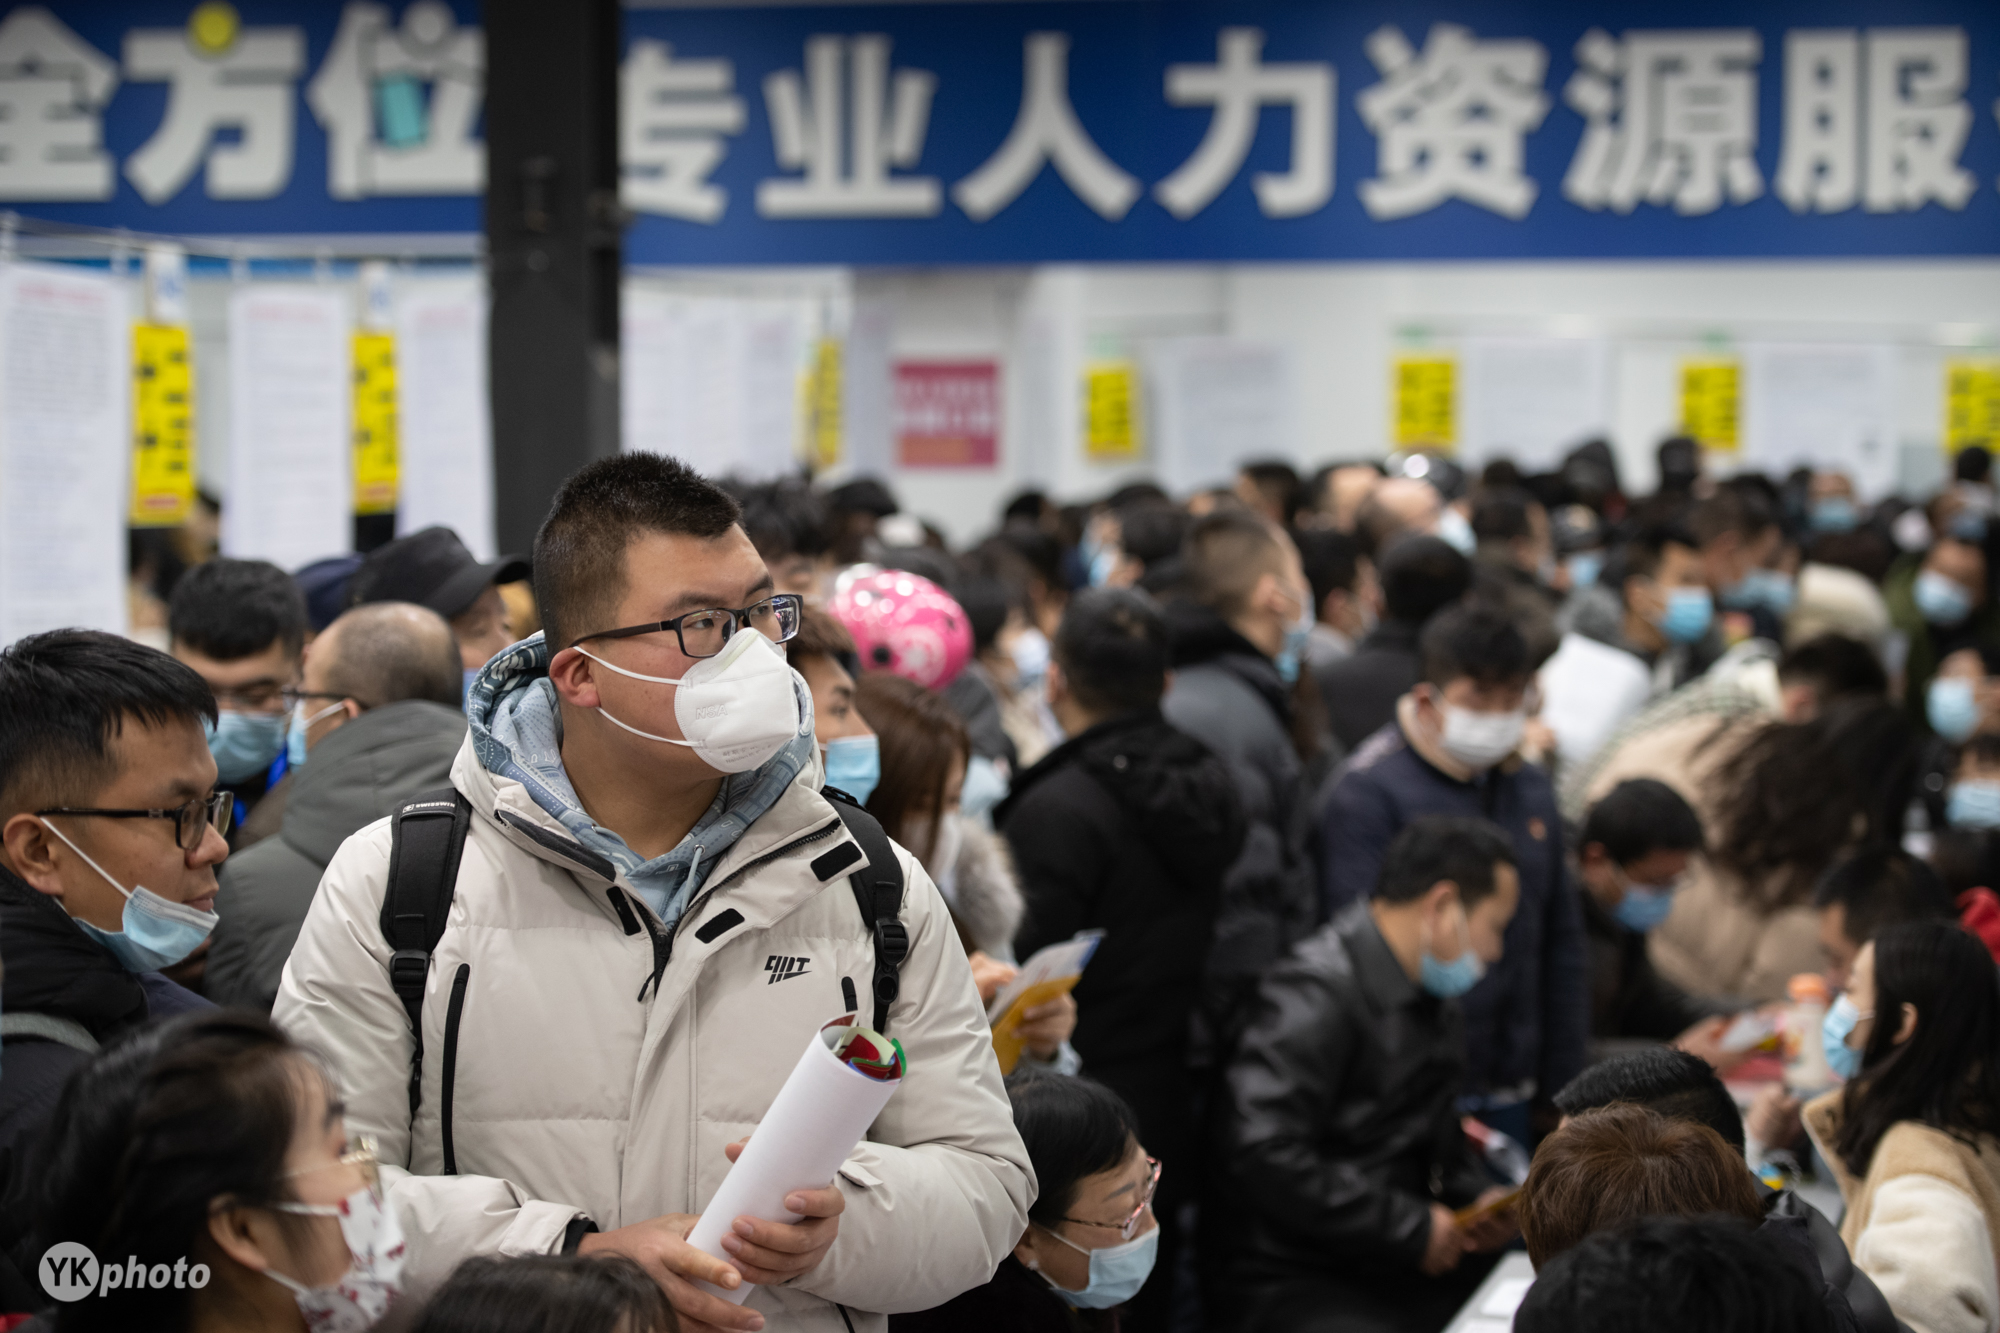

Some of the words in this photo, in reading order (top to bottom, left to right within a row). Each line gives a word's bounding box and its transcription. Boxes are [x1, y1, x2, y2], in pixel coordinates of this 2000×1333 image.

[0, 2, 485, 205] 全方位
[620, 23, 2000, 223] 专业人力资源服
[695, 703, 729, 720] NSA
